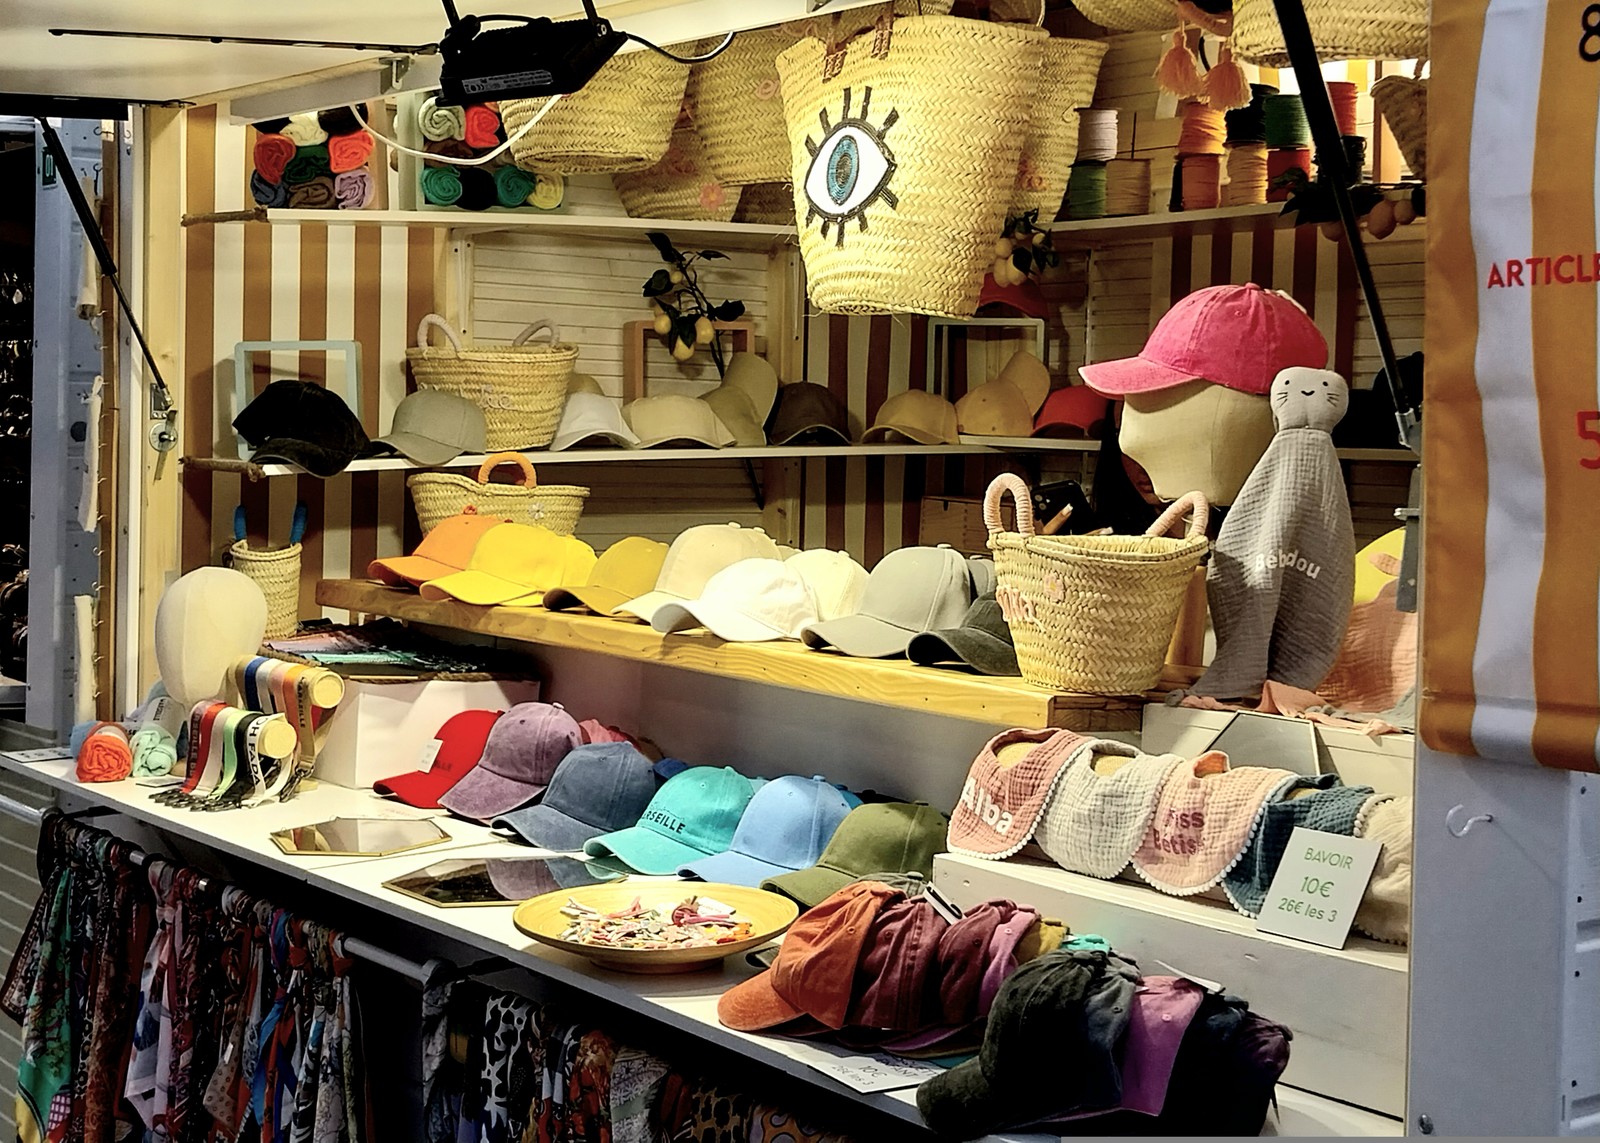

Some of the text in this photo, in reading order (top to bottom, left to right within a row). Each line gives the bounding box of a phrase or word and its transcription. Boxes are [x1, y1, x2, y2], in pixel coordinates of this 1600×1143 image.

[959, 776, 1013, 836] Alba
[1304, 847, 1353, 869] BAVOIR
[1300, 876, 1335, 898] 10€
[1278, 897, 1338, 922] 26€ les 3
